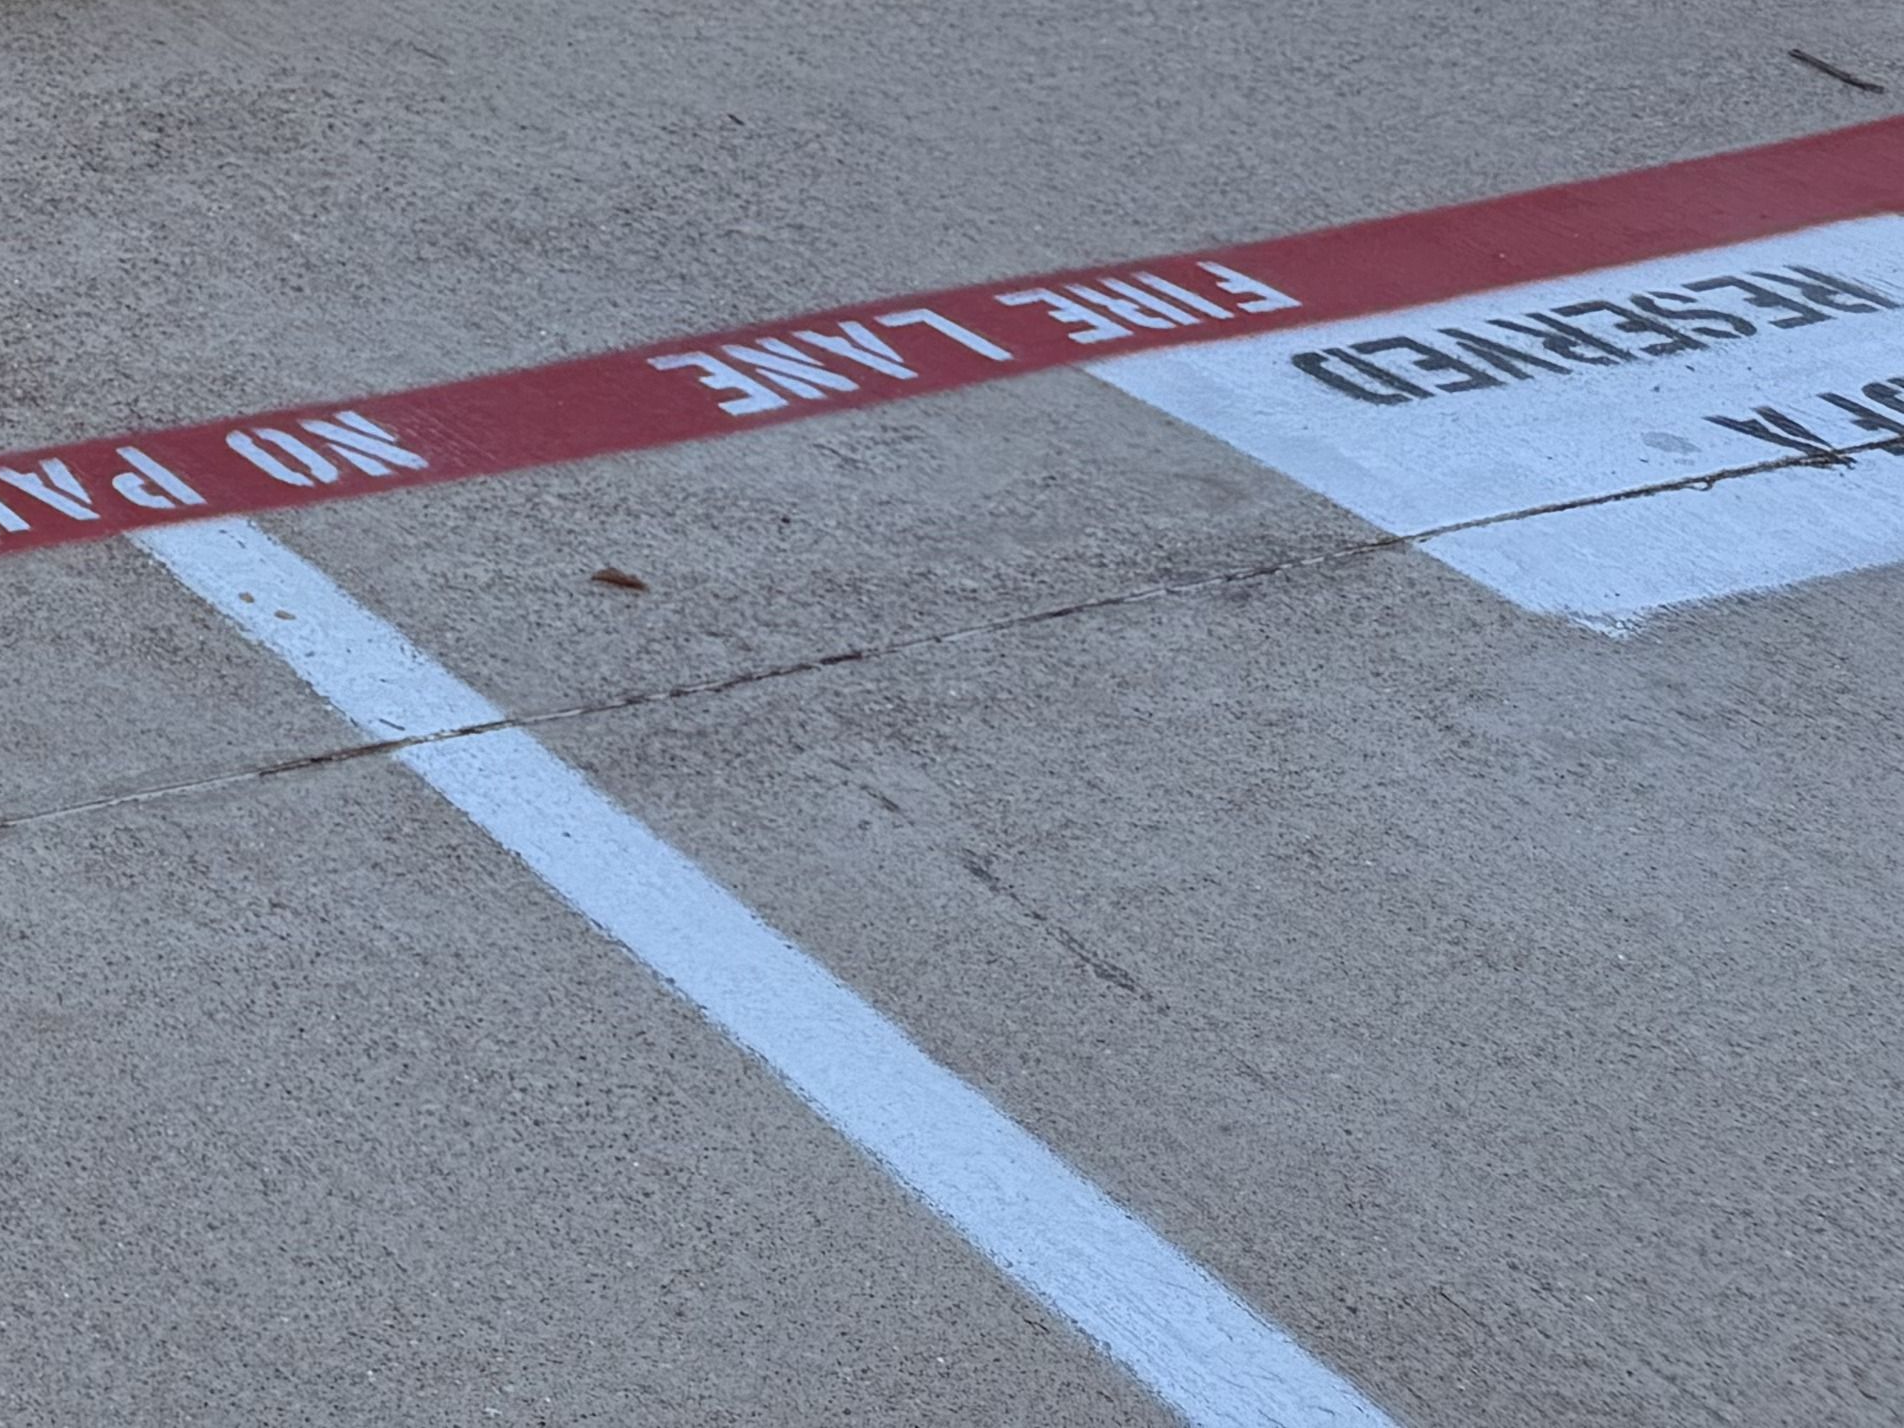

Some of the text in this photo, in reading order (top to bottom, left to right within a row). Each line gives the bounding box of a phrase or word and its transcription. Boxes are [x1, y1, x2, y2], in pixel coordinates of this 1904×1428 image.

[647, 260, 1302, 416] FIRE LANE
[1290, 264, 1904, 406] RESERVED
[225, 410, 429, 488] NO
